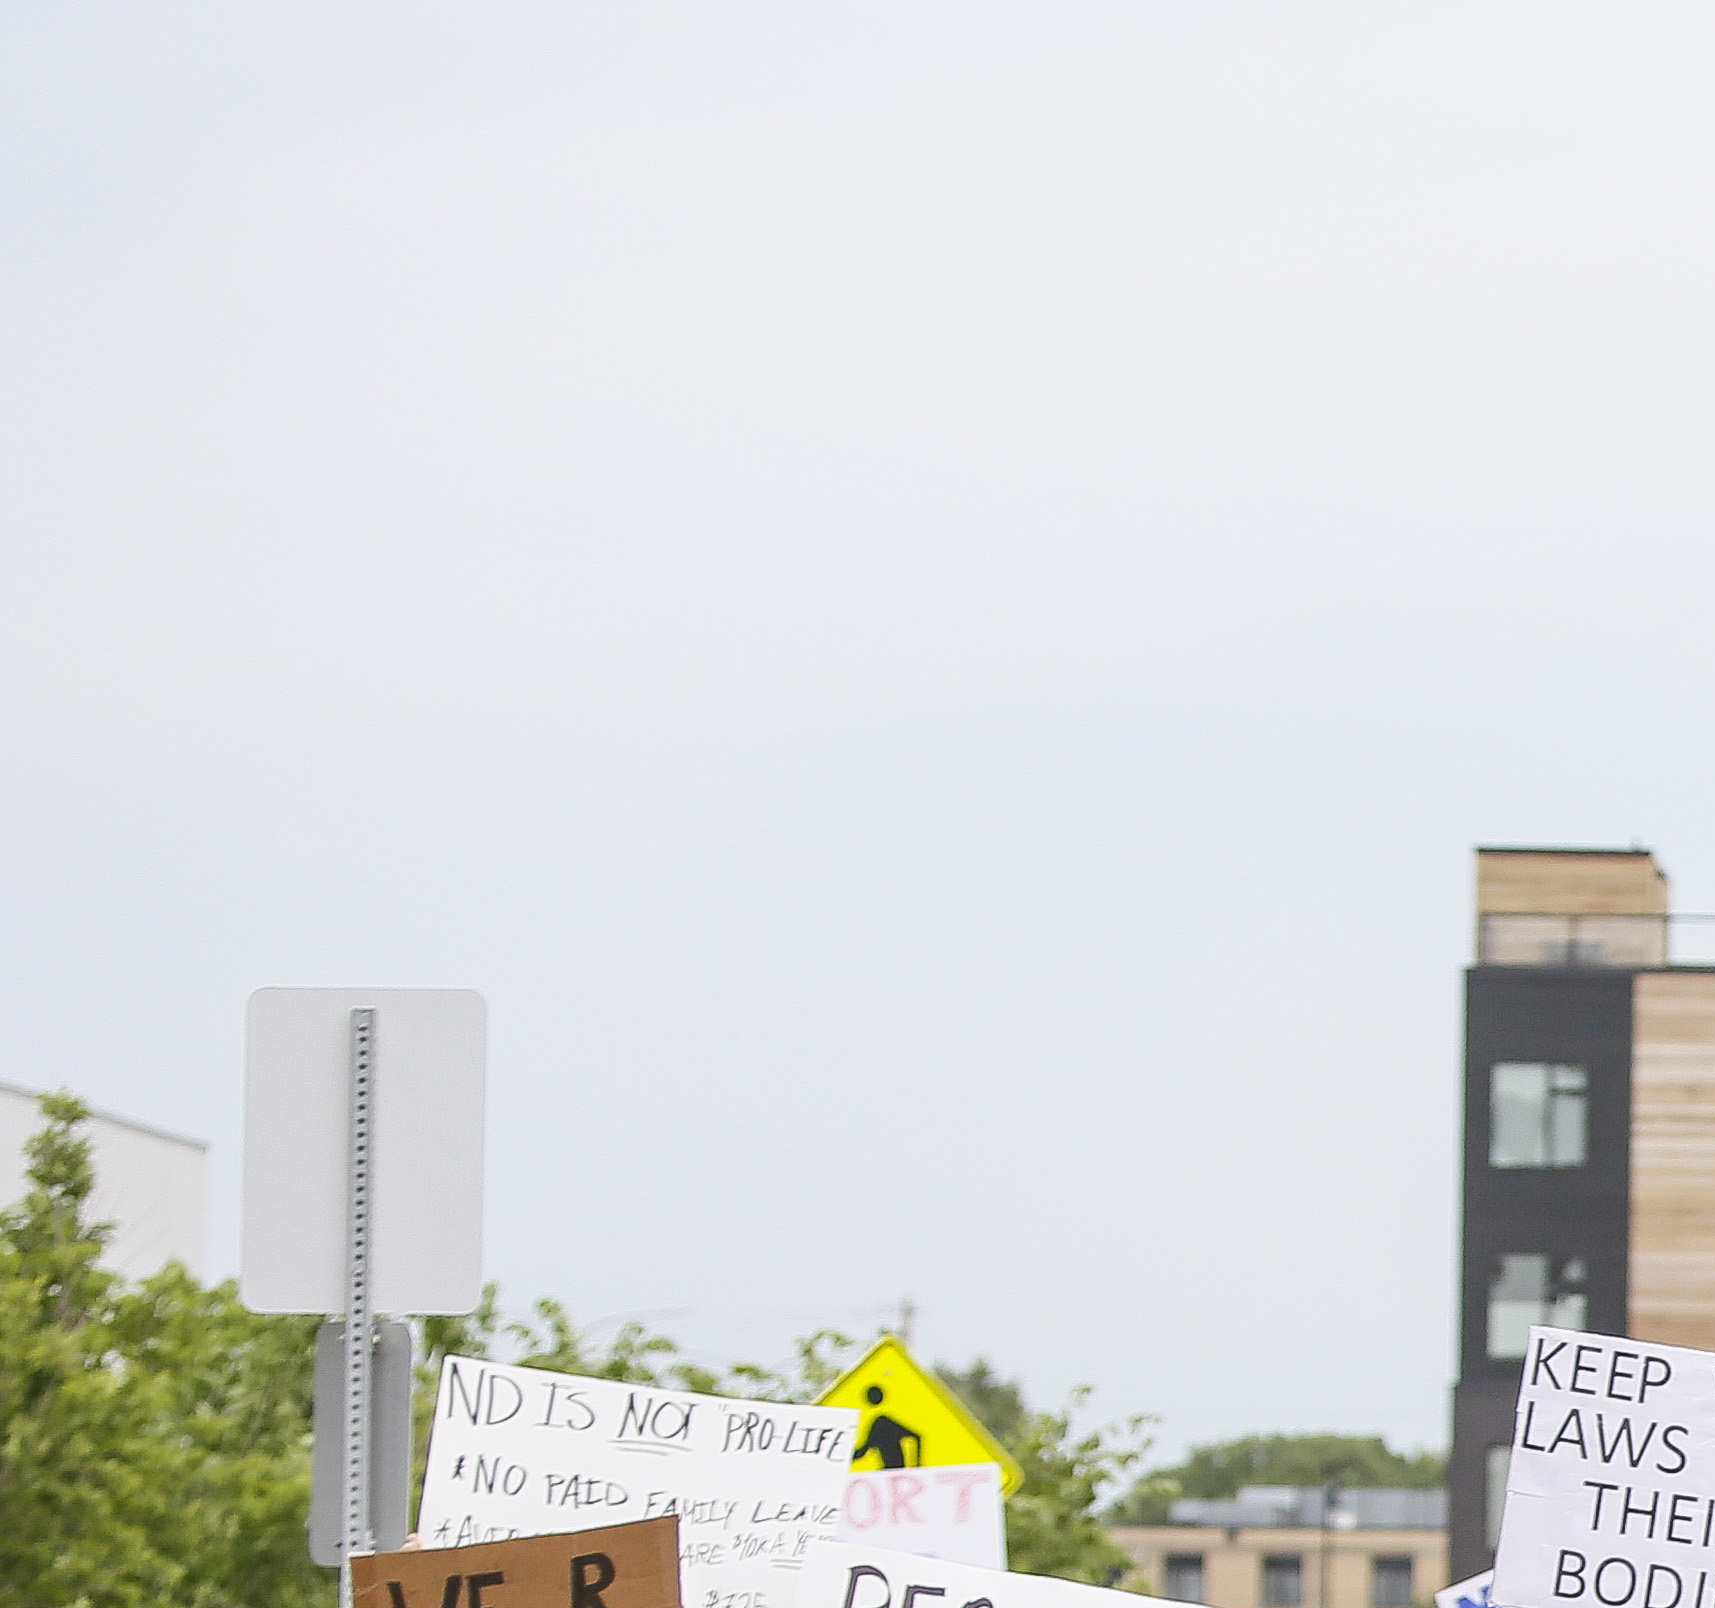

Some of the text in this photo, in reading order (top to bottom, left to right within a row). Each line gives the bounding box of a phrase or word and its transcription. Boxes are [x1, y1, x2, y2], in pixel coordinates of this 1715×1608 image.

[446, 1362, 523, 1427] ND
[535, 1382, 597, 1431] IS
[617, 1393, 700, 1440] NOT
[1529, 1336, 1672, 1405] KEEP
[1521, 1402, 1689, 1476] LAWS
[544, 1473, 628, 1507] PAID
[643, 1491, 735, 1526] FAMILY
[751, 1499, 841, 1525] LEAVE
